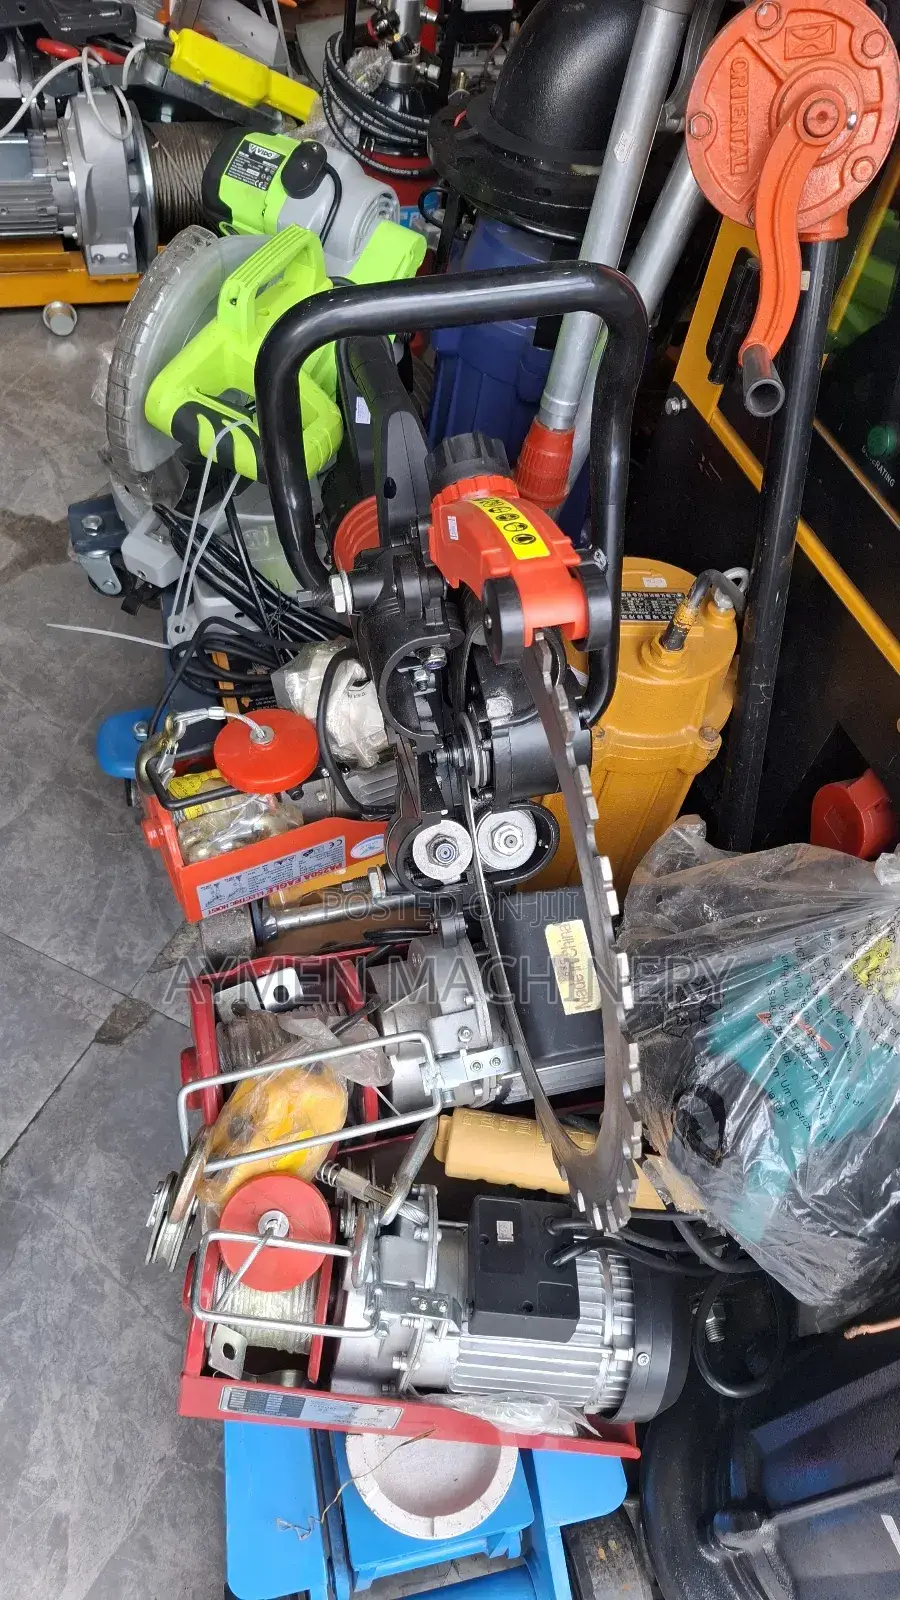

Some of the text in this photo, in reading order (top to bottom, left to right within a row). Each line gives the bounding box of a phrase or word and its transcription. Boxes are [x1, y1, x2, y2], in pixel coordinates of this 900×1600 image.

[730, 57, 748, 175] ORIENTAL
[266, 876, 302, 898] EAGLE
[207, 902, 230, 915] HOIST
